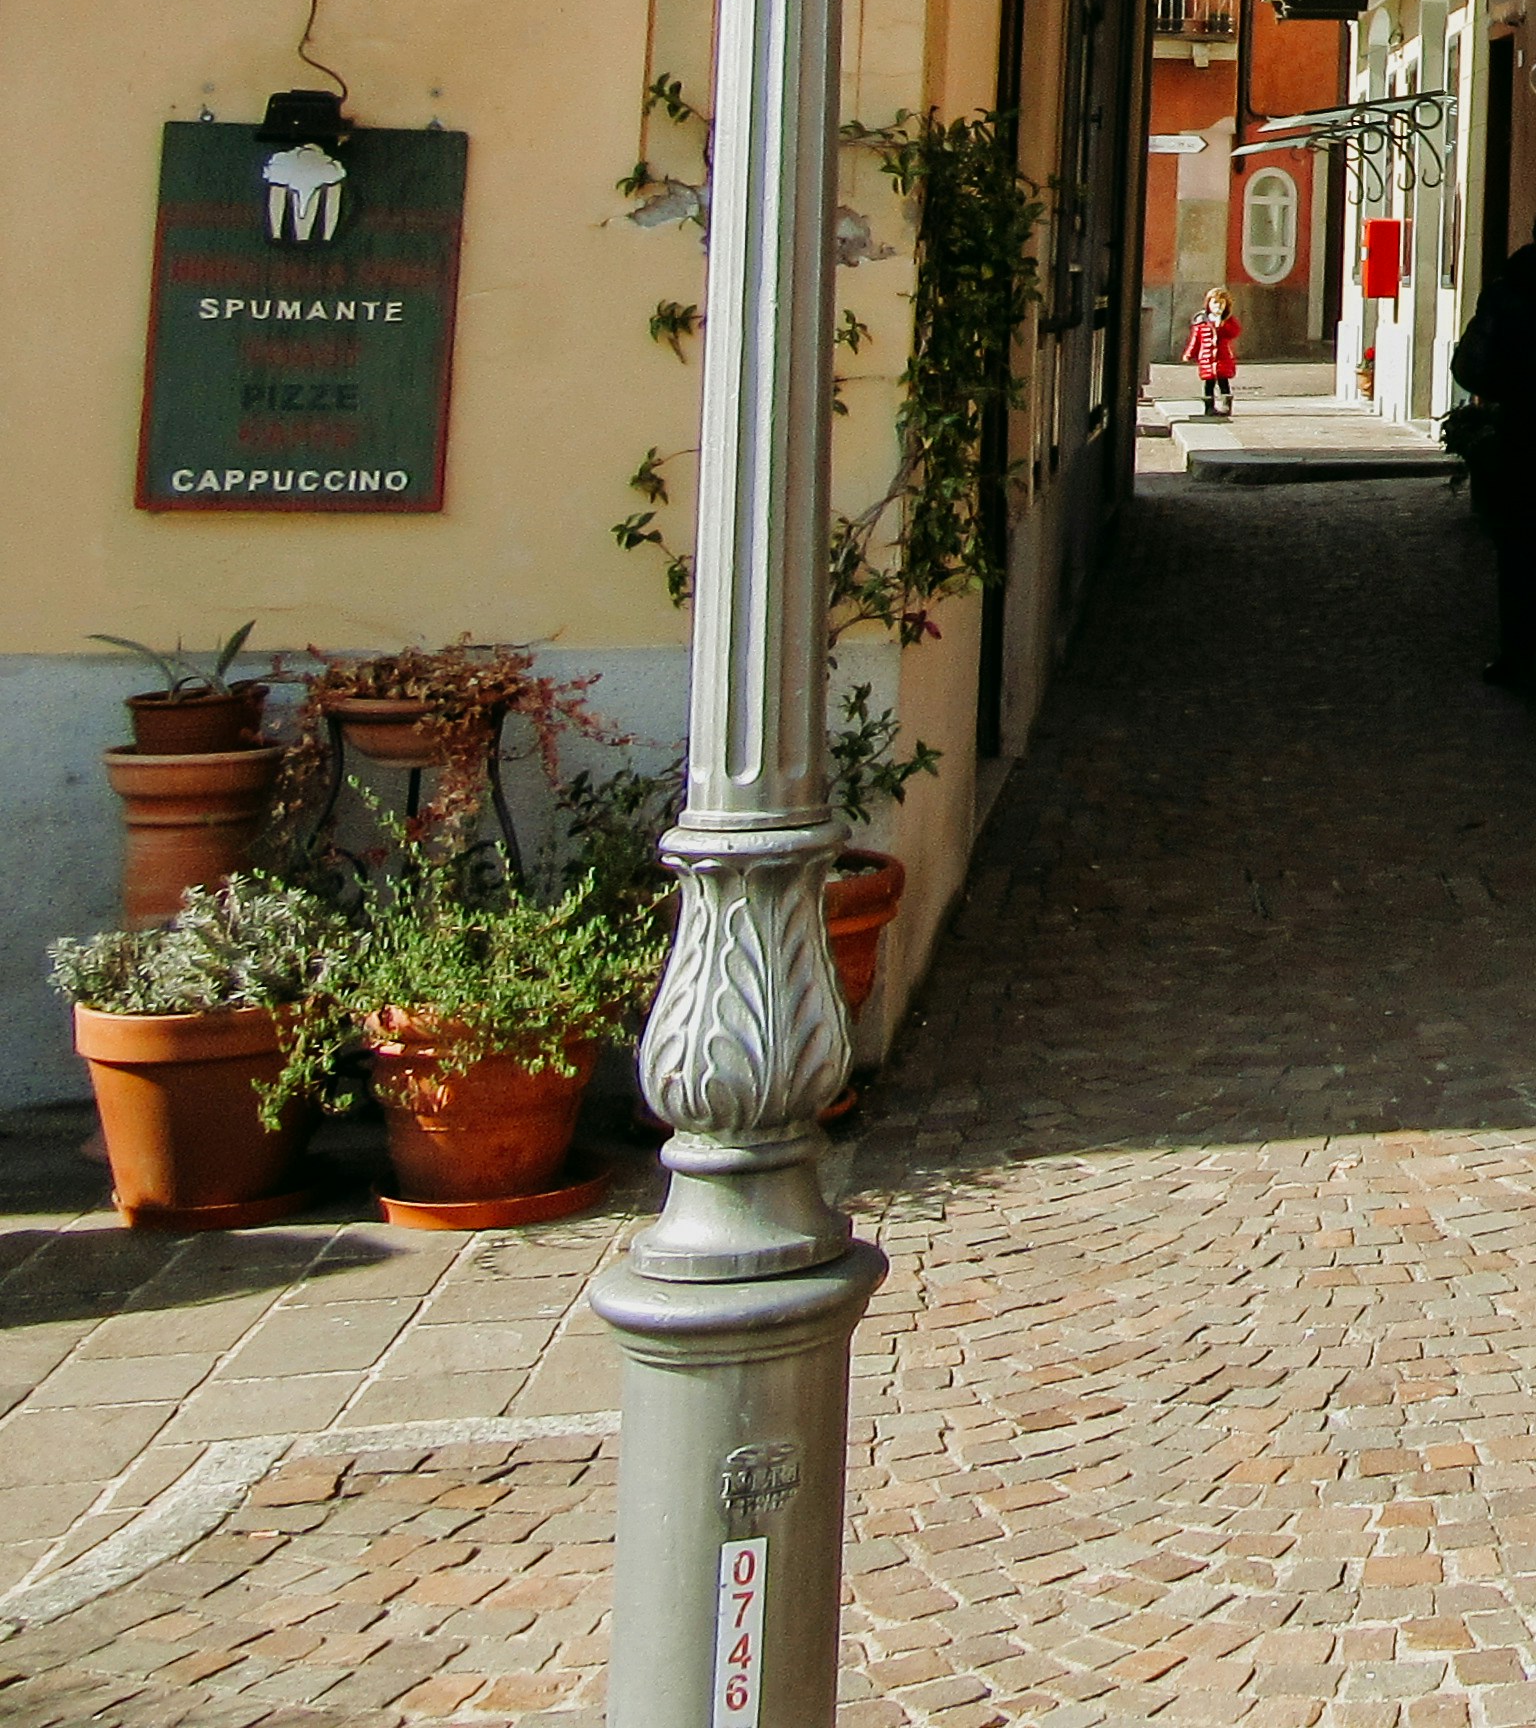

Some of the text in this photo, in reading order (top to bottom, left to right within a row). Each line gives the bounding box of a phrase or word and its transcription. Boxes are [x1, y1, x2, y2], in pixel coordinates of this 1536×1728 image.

[199, 298, 404, 322] SPUMANTE
[241, 383, 359, 411] PIZZE
[172, 468, 410, 493] CAPPUCCINO
[725, 1549, 756, 1712] 0746
